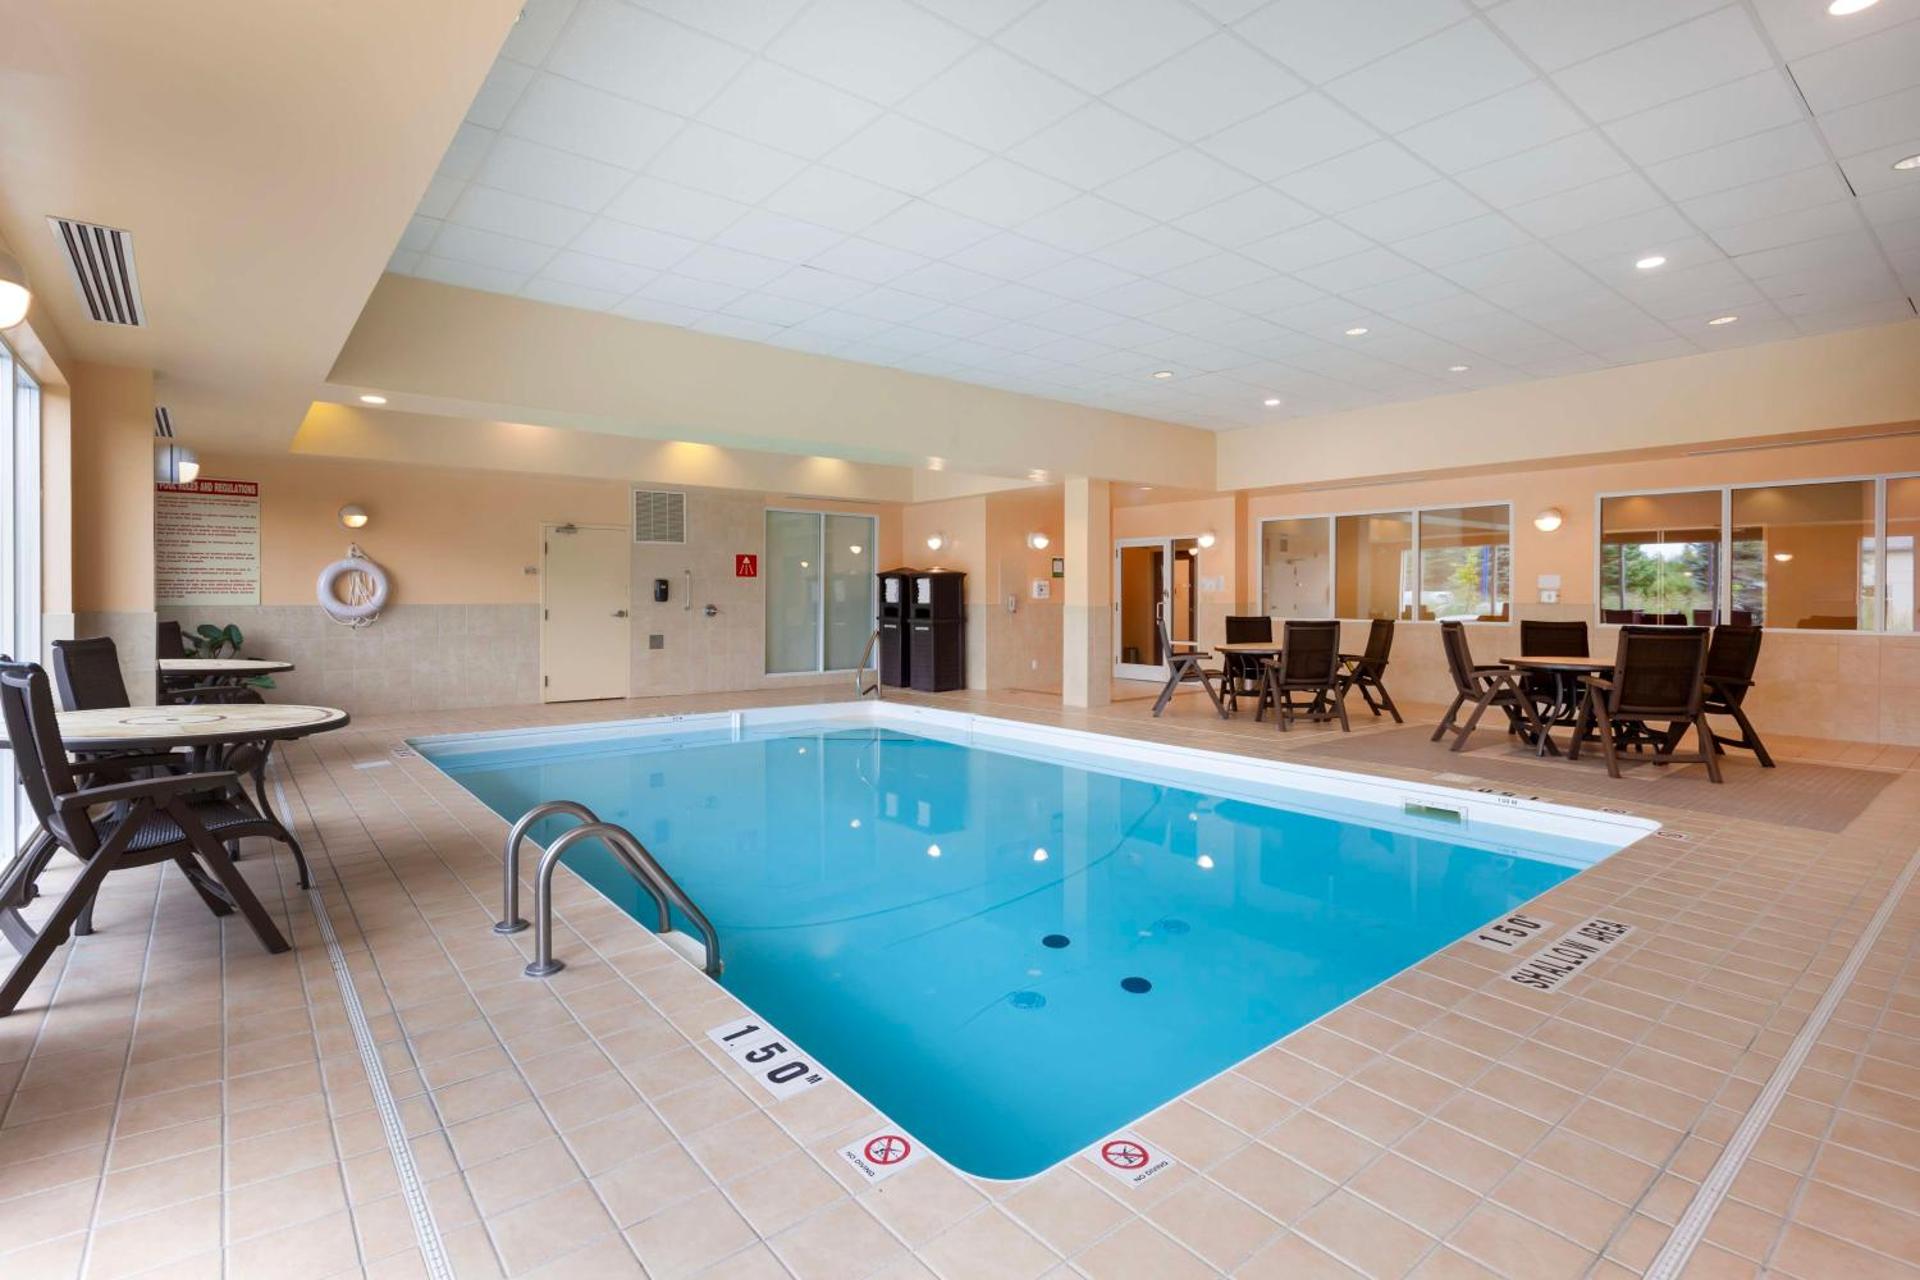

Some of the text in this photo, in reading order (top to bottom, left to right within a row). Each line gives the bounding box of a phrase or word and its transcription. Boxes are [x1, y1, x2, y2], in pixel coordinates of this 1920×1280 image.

[200, 482, 213, 493] AND
[214, 482, 256, 495] REGULATIONS
[1511, 919, 1632, 990] SHALLOW AREA
